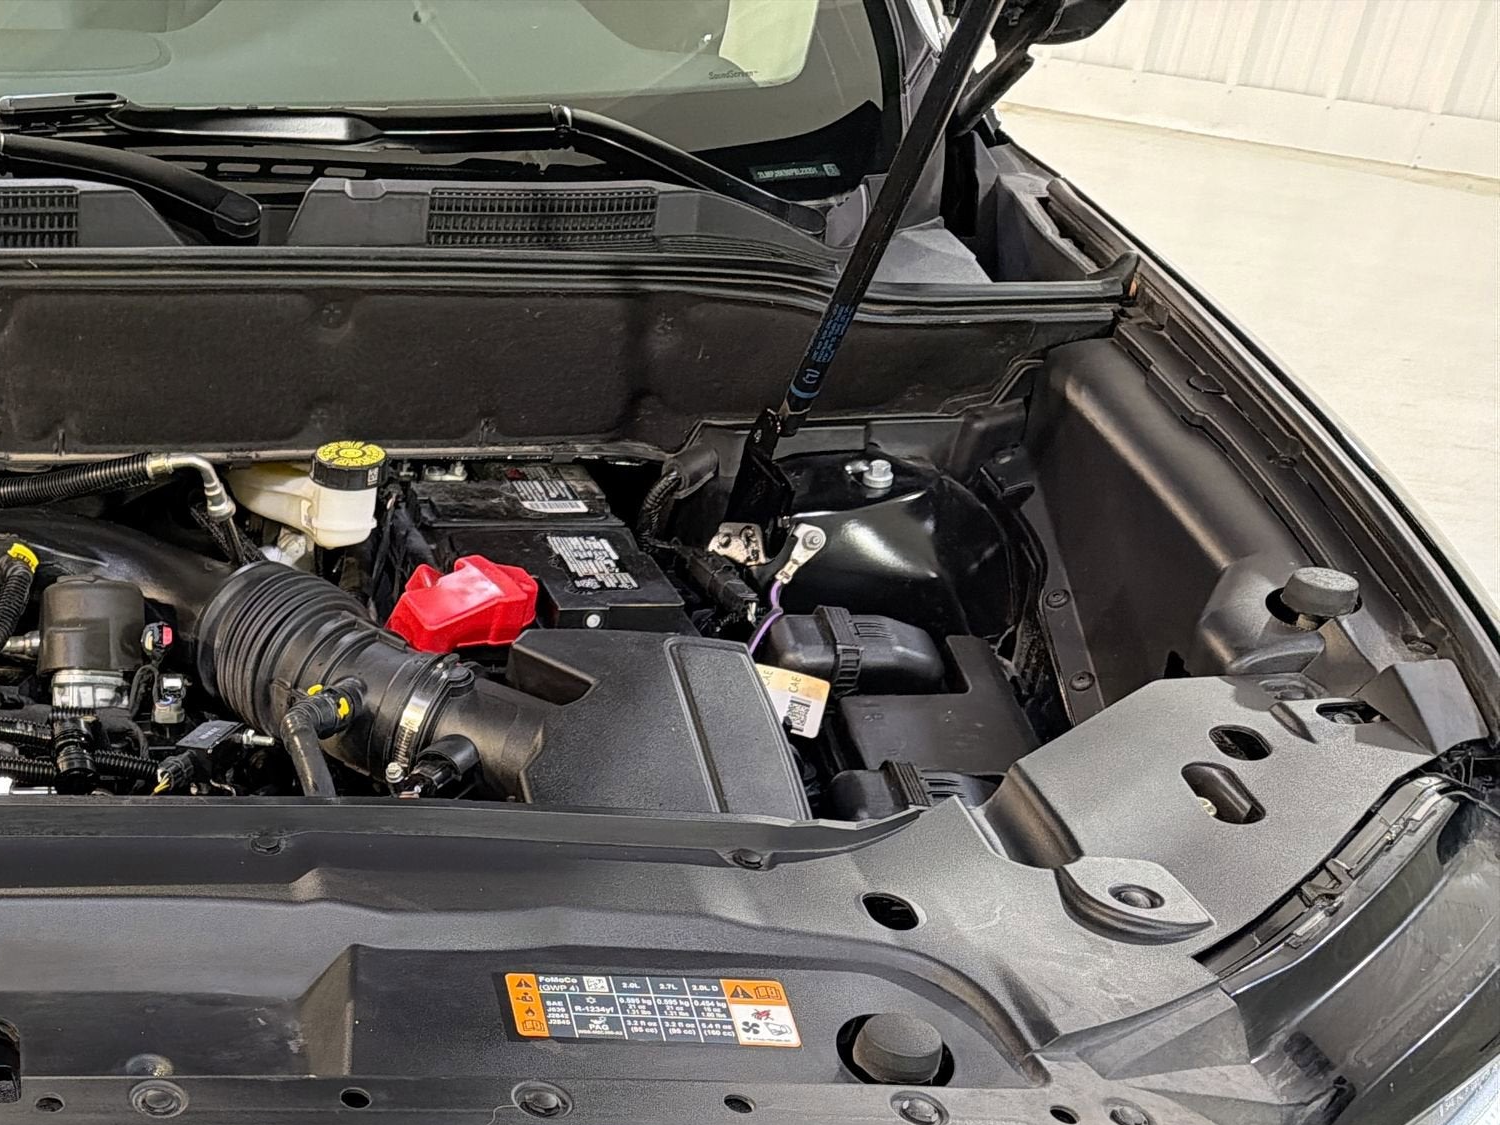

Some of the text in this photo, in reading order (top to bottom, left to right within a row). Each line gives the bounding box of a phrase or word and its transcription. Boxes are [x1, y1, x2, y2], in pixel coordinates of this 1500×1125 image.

[788, 675, 802, 694] CAE
[539, 976, 578, 984] FoMoCo
[539, 984, 580, 993] (GWP 4)
[641, 998, 653, 1006] kg
[679, 999, 690, 1007] kg
[716, 1001, 727, 1009] kg
[574, 1004, 615, 1014] R-1234yf
[588, 1023, 610, 1031] PAG
